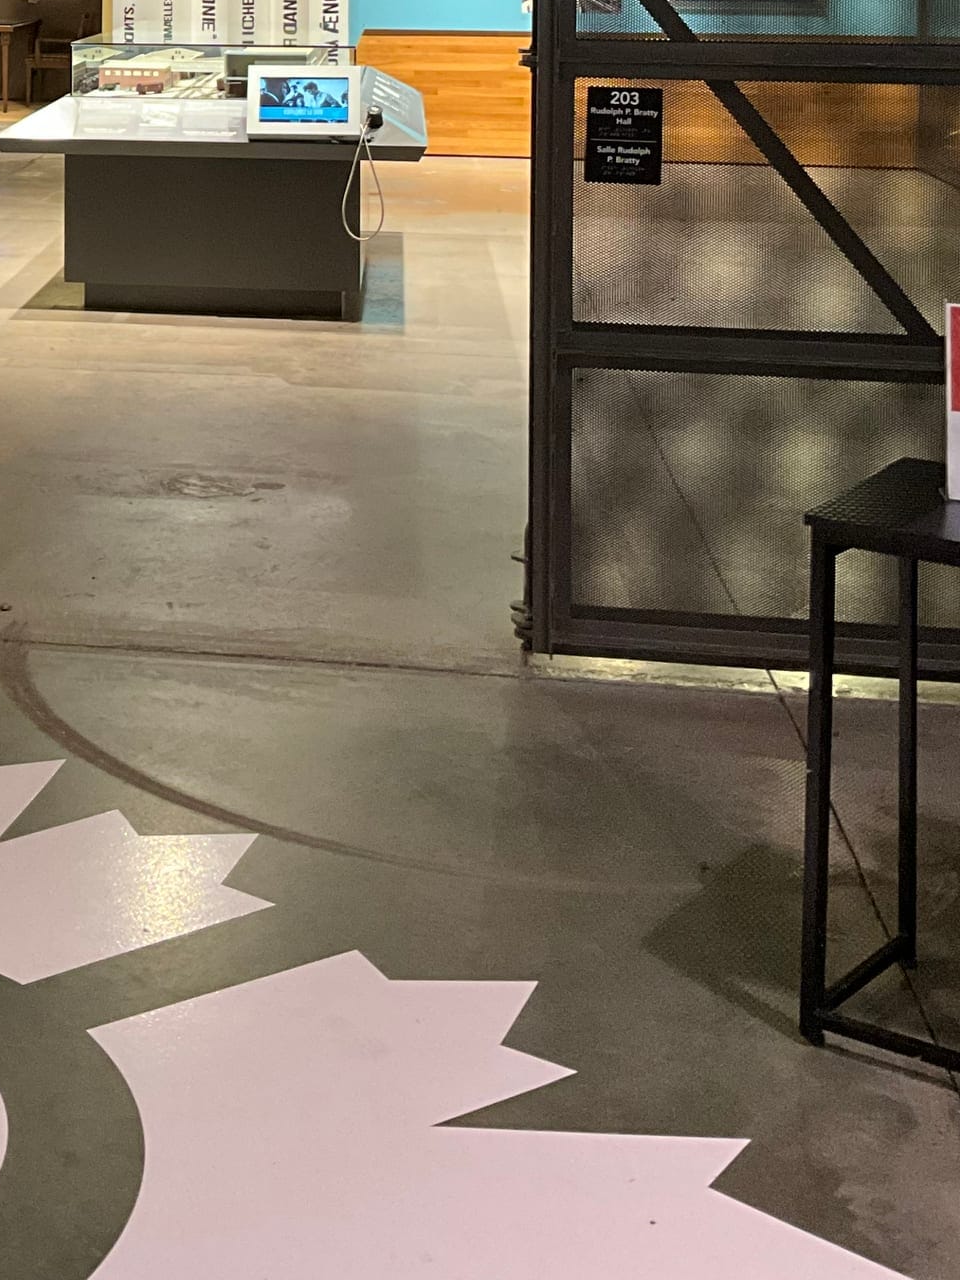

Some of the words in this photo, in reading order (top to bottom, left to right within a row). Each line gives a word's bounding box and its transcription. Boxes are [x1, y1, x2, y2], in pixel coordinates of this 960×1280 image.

[610, 91, 640, 105] 203
[590, 106, 624, 116] Rudolph
[633, 108, 659, 118] Bratty
[616, 117, 632, 125] Hall
[597, 145, 616, 153] Salle
[617, 146, 651, 156] Rudolph
[616, 156, 640, 166] Bratty
